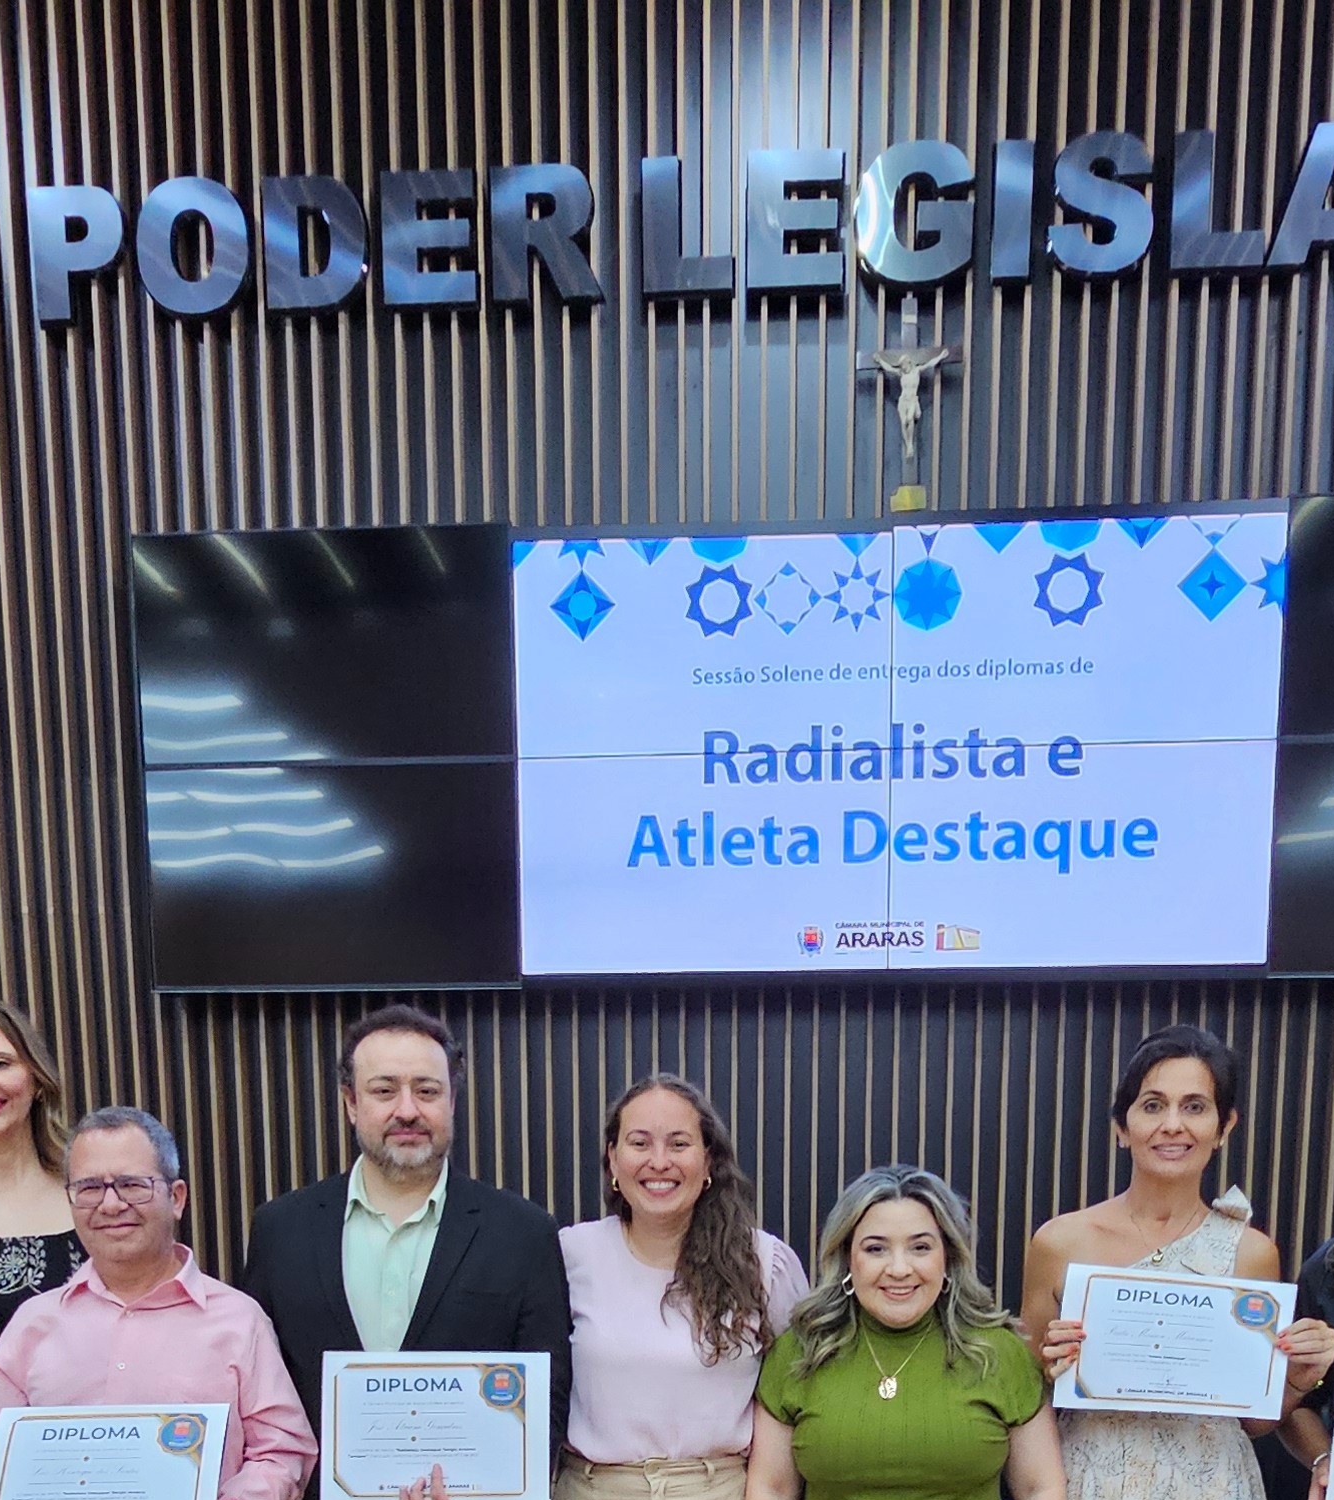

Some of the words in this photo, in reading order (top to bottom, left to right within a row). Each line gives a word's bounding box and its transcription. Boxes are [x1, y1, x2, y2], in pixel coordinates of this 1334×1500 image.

[27, 163, 605, 329] PODER
[692, 666, 756, 685] Sessão
[760, 664, 824, 683] Solene
[829, 662, 853, 680] de
[857, 663, 931, 684] entrega
[936, 659, 971, 678] dos
[975, 657, 1065, 681] diplomas
[1070, 655, 1095, 675] de
[702, 722, 1028, 786] Radialista
[1046, 734, 1084, 778] e
[626, 810, 820, 869] Atleta
[841, 808, 1160, 875] Destaque
[834, 920, 868, 929] CÂMARA
[870, 920, 912, 929] MUNICIPAL
[913, 920, 925, 928] DE
[835, 930, 925, 949] ARARAS
[1116, 1288, 1214, 1309] DIPLOMA
[366, 1377, 463, 1393] DIPLOMA
[41, 1426, 141, 1442] DIPLOMA
